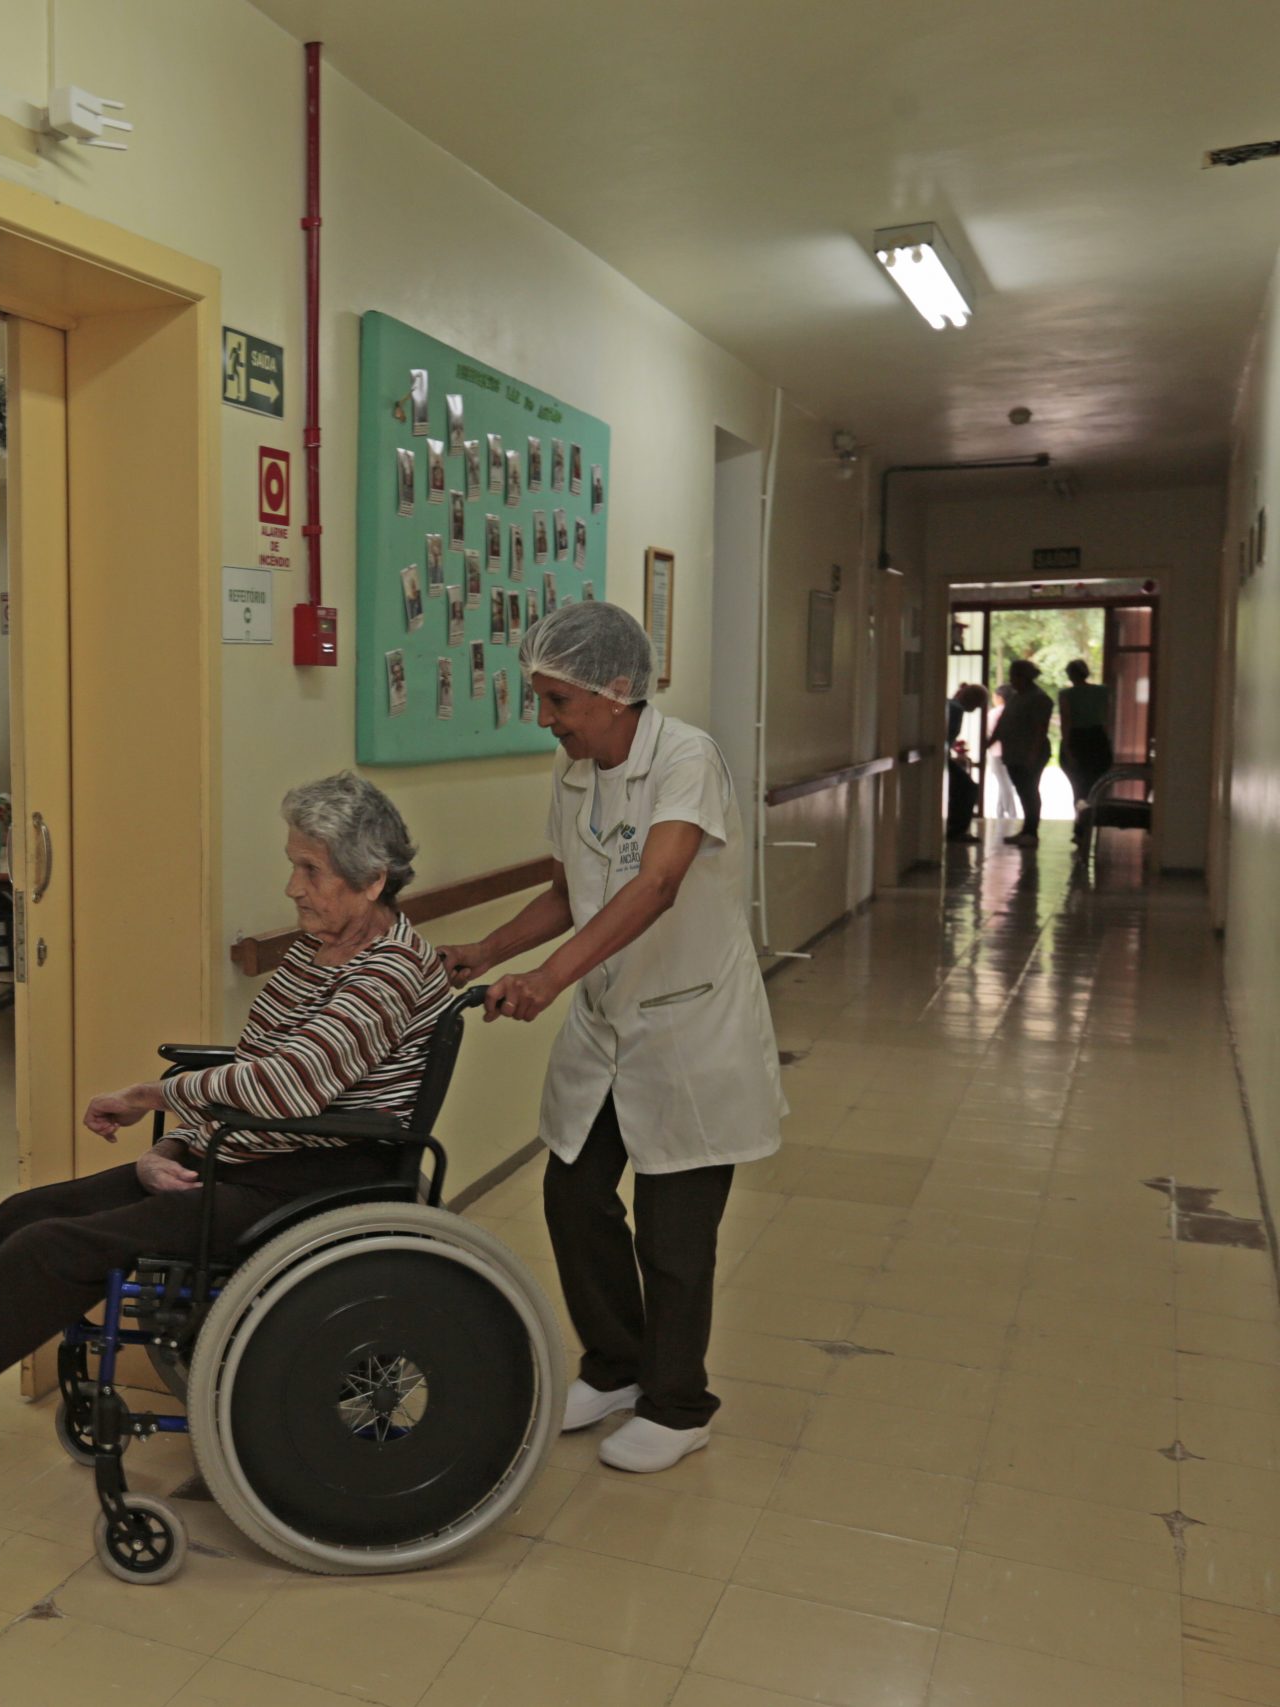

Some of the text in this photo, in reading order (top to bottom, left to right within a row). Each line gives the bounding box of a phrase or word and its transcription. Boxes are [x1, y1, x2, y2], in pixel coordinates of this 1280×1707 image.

[261, 525, 288, 540] ALARME
[270, 540, 280, 552] DE
[258, 553, 290, 568] INCÊNDIO
[228, 587, 266, 604] REFEITÓRIO
[619, 841, 639, 854] LAR DO
